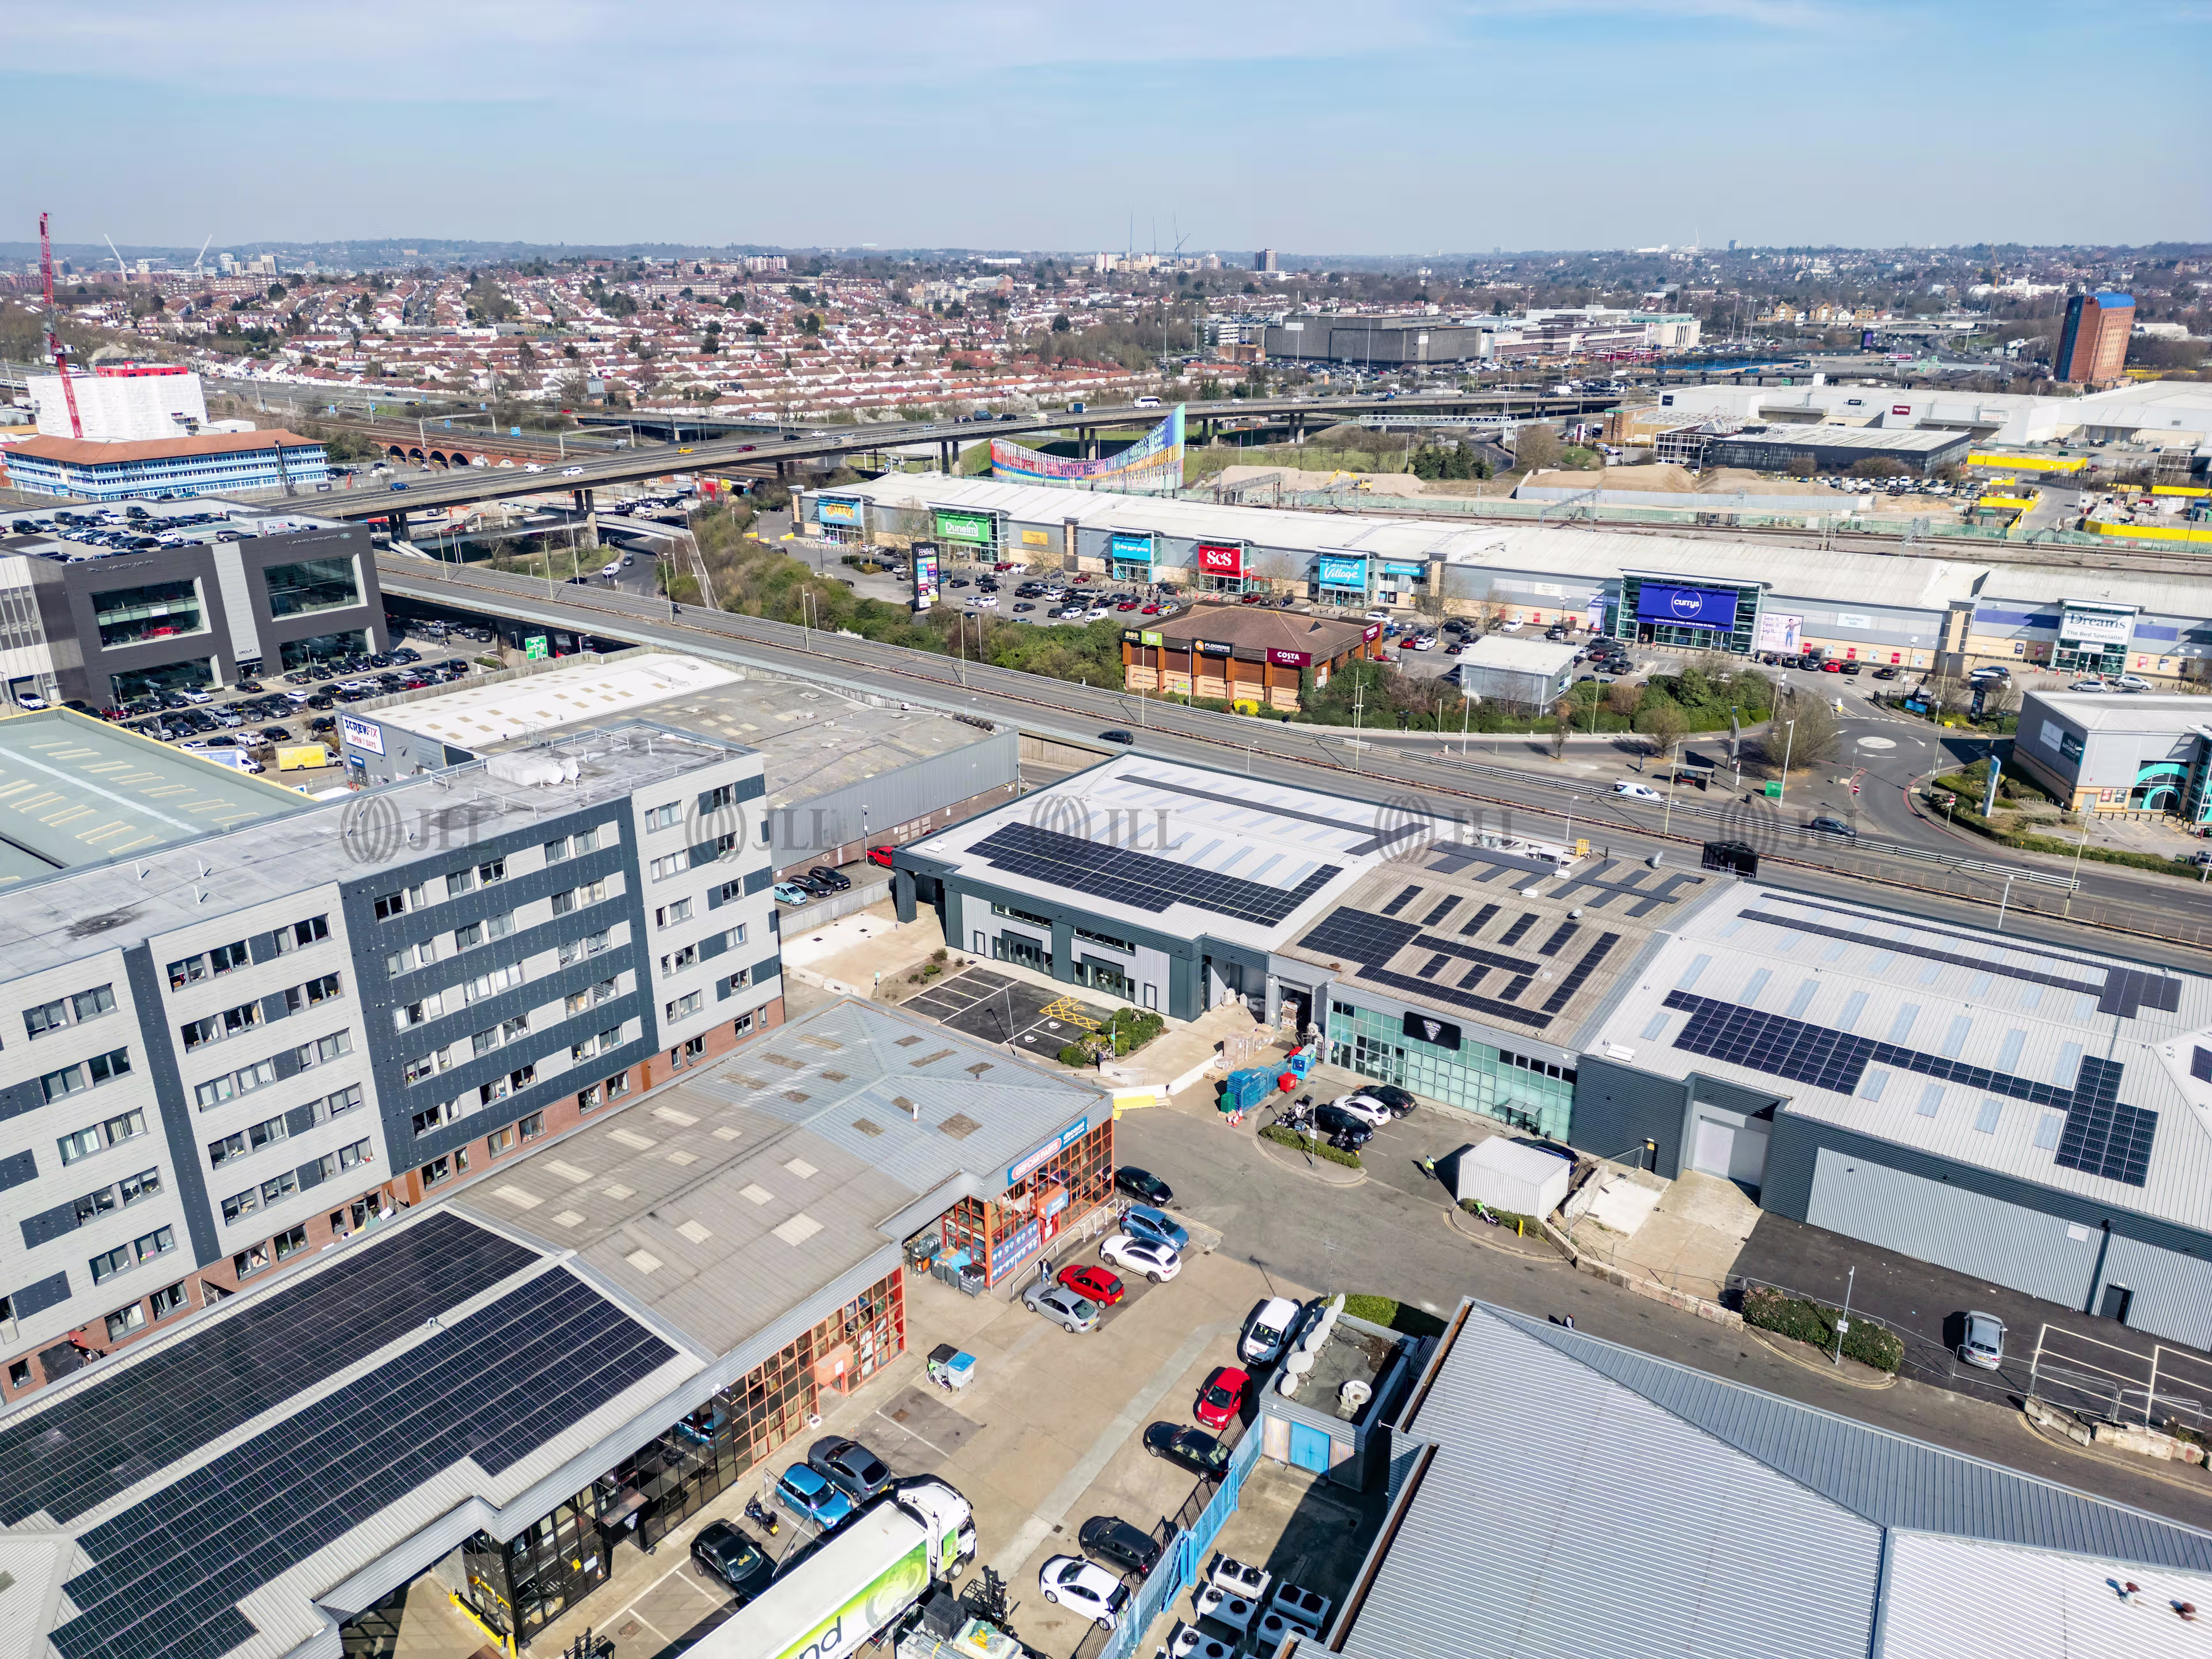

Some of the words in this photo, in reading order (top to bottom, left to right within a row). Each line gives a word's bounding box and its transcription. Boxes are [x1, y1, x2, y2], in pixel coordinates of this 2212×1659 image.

[945, 521, 976, 534] Dunelm
[1207, 551, 1232, 566] ScS
[1324, 567, 1360, 582] Village
[1673, 599, 1700, 608] currys
[2069, 613, 2126, 630] Dreams
[2093, 632, 2124, 641] Specialist
[1205, 642, 1230, 650] FLOORING
[1277, 652, 1300, 661] COSTA
[351, 734, 362, 744] OPEN
[366, 740, 377, 749] DAYS
[1063, 1120, 1085, 1141] discount
[1028, 1153, 1040, 1168] CAR
[1040, 1141, 1058, 1160] PARTS
